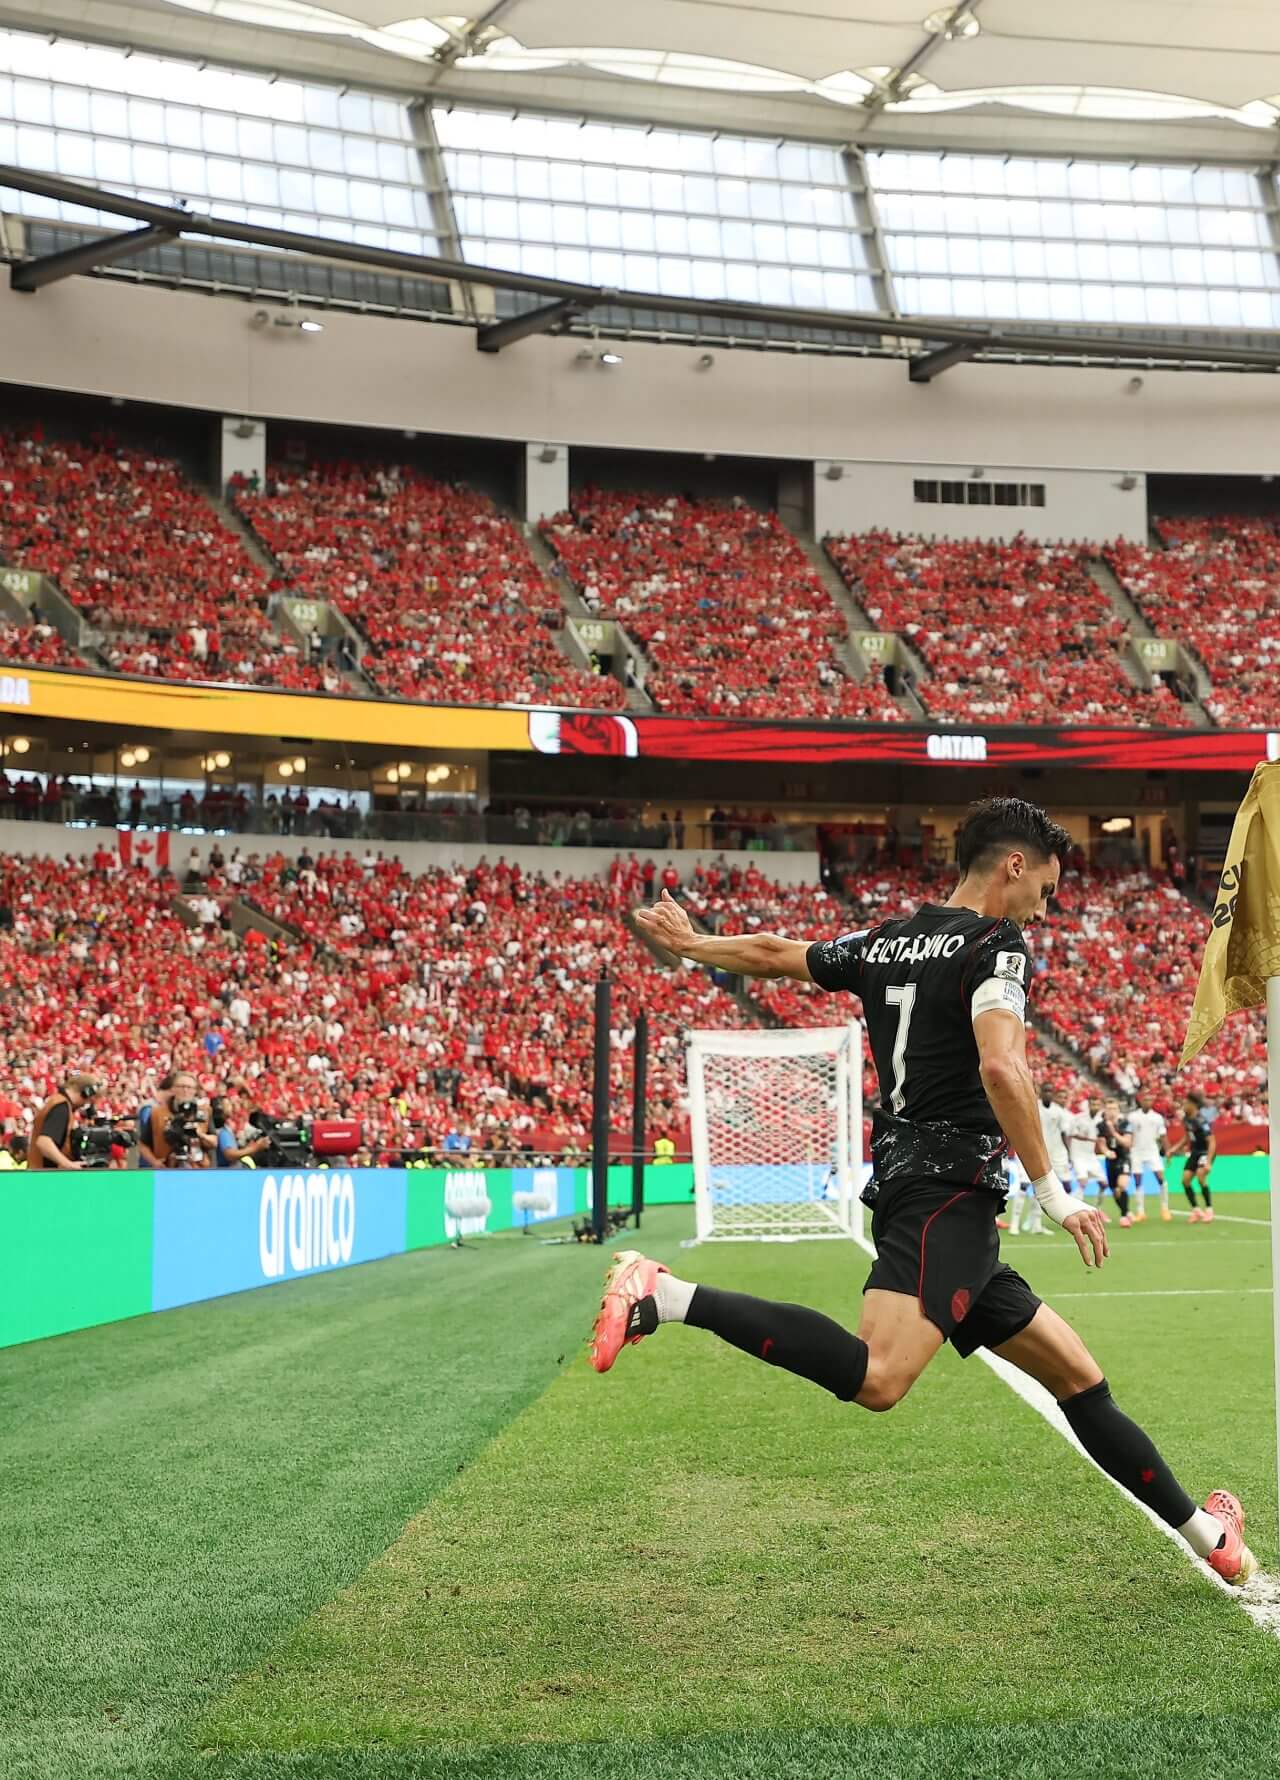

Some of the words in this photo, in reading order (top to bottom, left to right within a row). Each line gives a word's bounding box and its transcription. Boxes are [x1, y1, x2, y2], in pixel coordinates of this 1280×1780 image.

[2, 574, 29, 592] 434
[293, 603, 317, 621] 435
[580, 623, 603, 641] 436
[862, 636, 885, 651] 437
[1143, 643, 1166, 658] 438
[926, 734, 987, 760] QATAR
[885, 982, 917, 1115] 7
[259, 1172, 355, 1278] aramco
